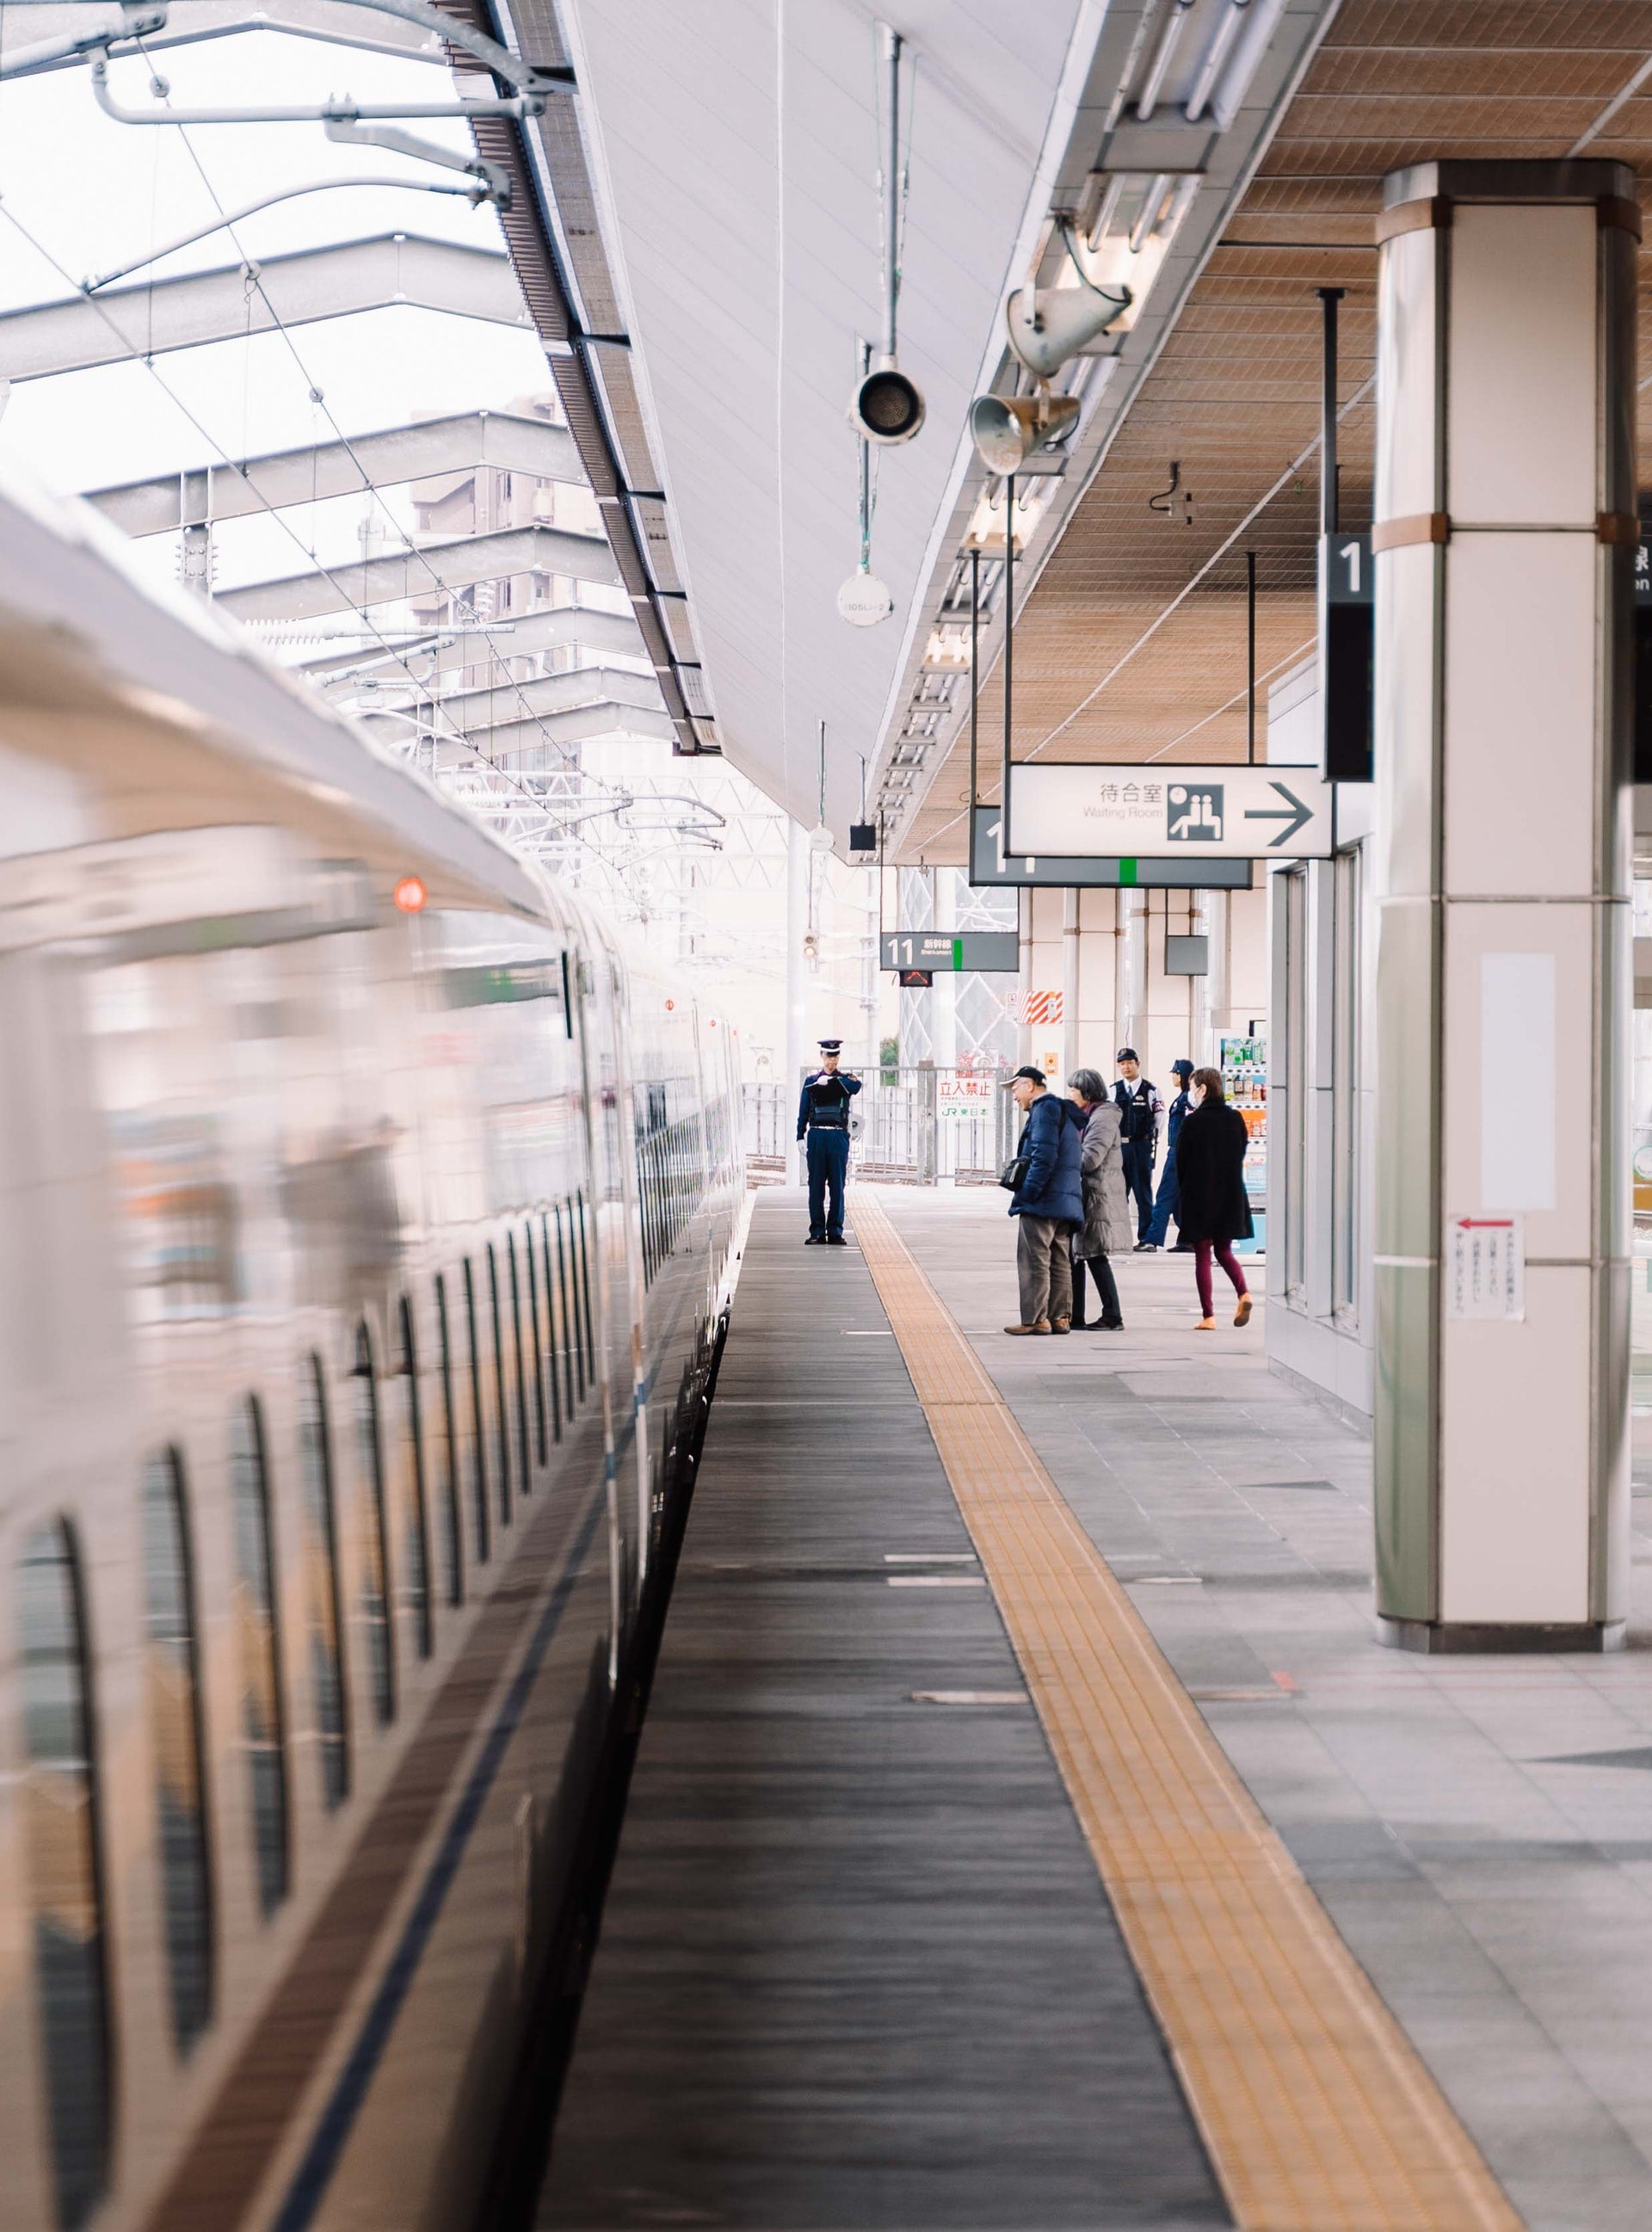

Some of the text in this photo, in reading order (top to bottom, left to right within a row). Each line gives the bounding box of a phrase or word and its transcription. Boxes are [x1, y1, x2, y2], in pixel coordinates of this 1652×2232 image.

[1100, 782, 1162, 803] 待合室
[1083, 806, 1163, 819] Waiting Room
[887, 938, 913, 965] 11
[940, 1081, 991, 1096] 立入禁止
